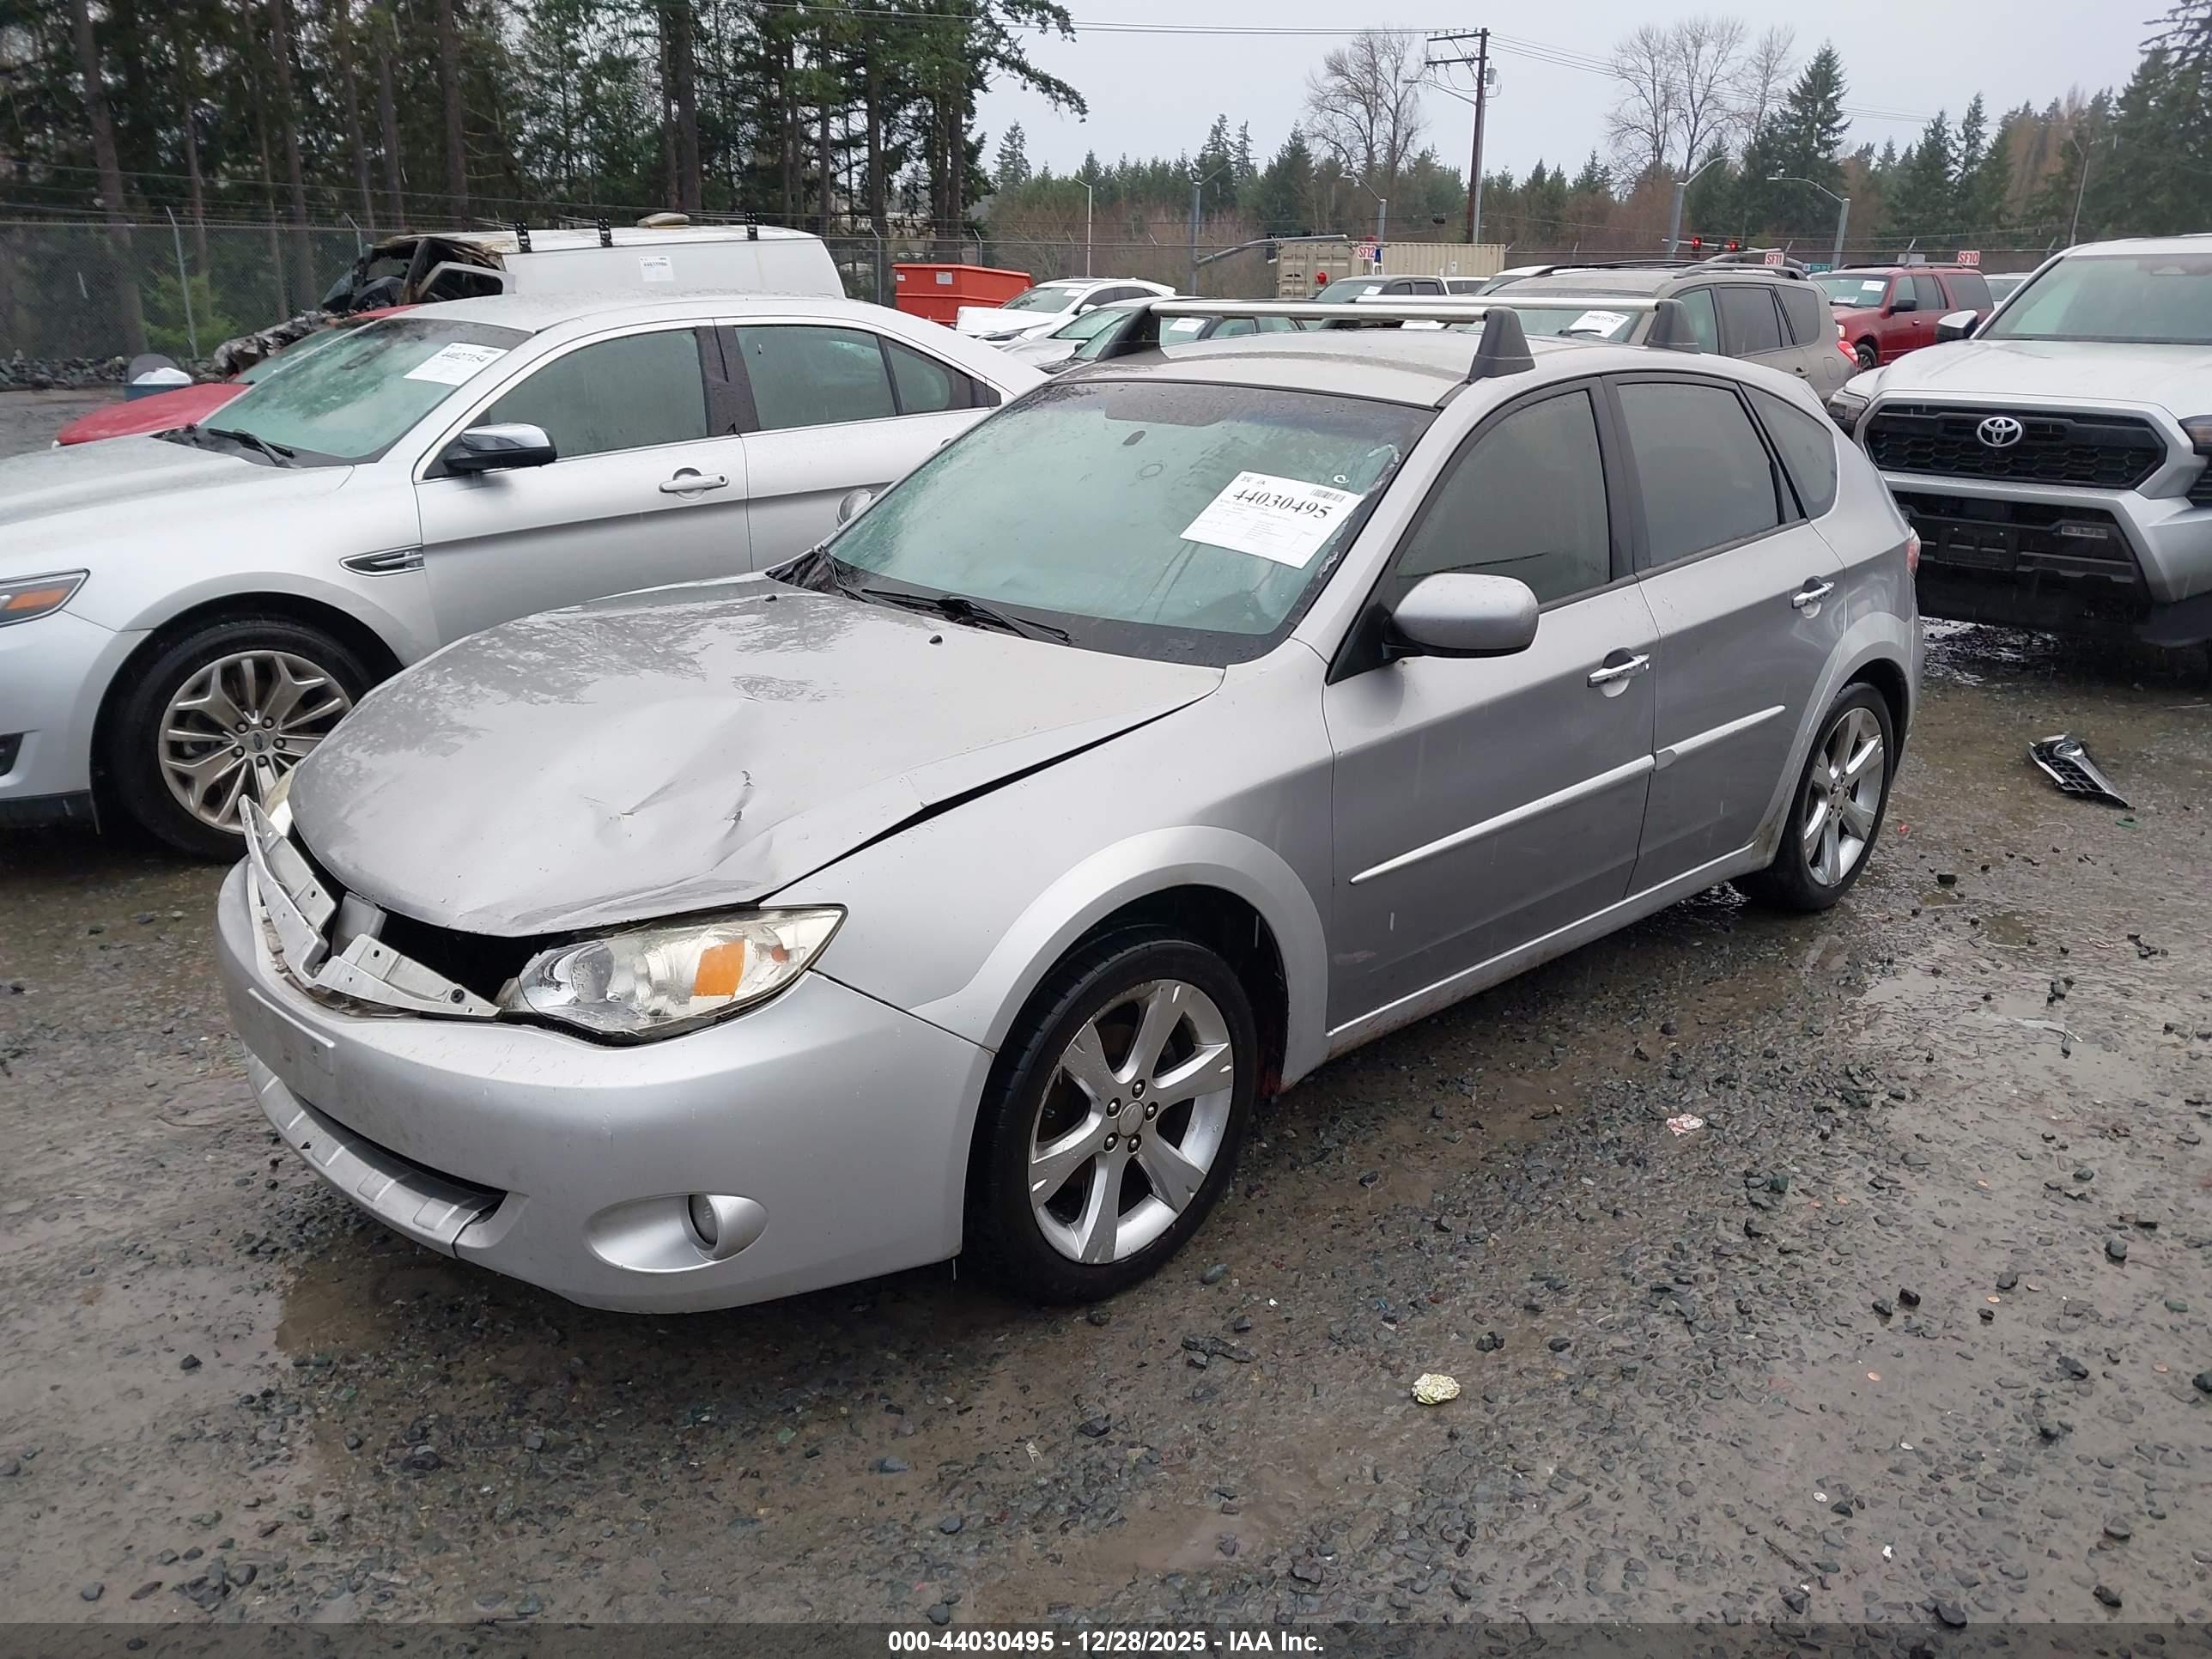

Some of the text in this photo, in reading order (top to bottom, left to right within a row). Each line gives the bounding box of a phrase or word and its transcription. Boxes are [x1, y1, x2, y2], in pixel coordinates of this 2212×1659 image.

[1358, 246, 1375, 258] SF12
[1959, 252, 1979, 264] SF10
[1766, 253, 1783, 265] SF11
[1233, 489, 1333, 519] 44030495
